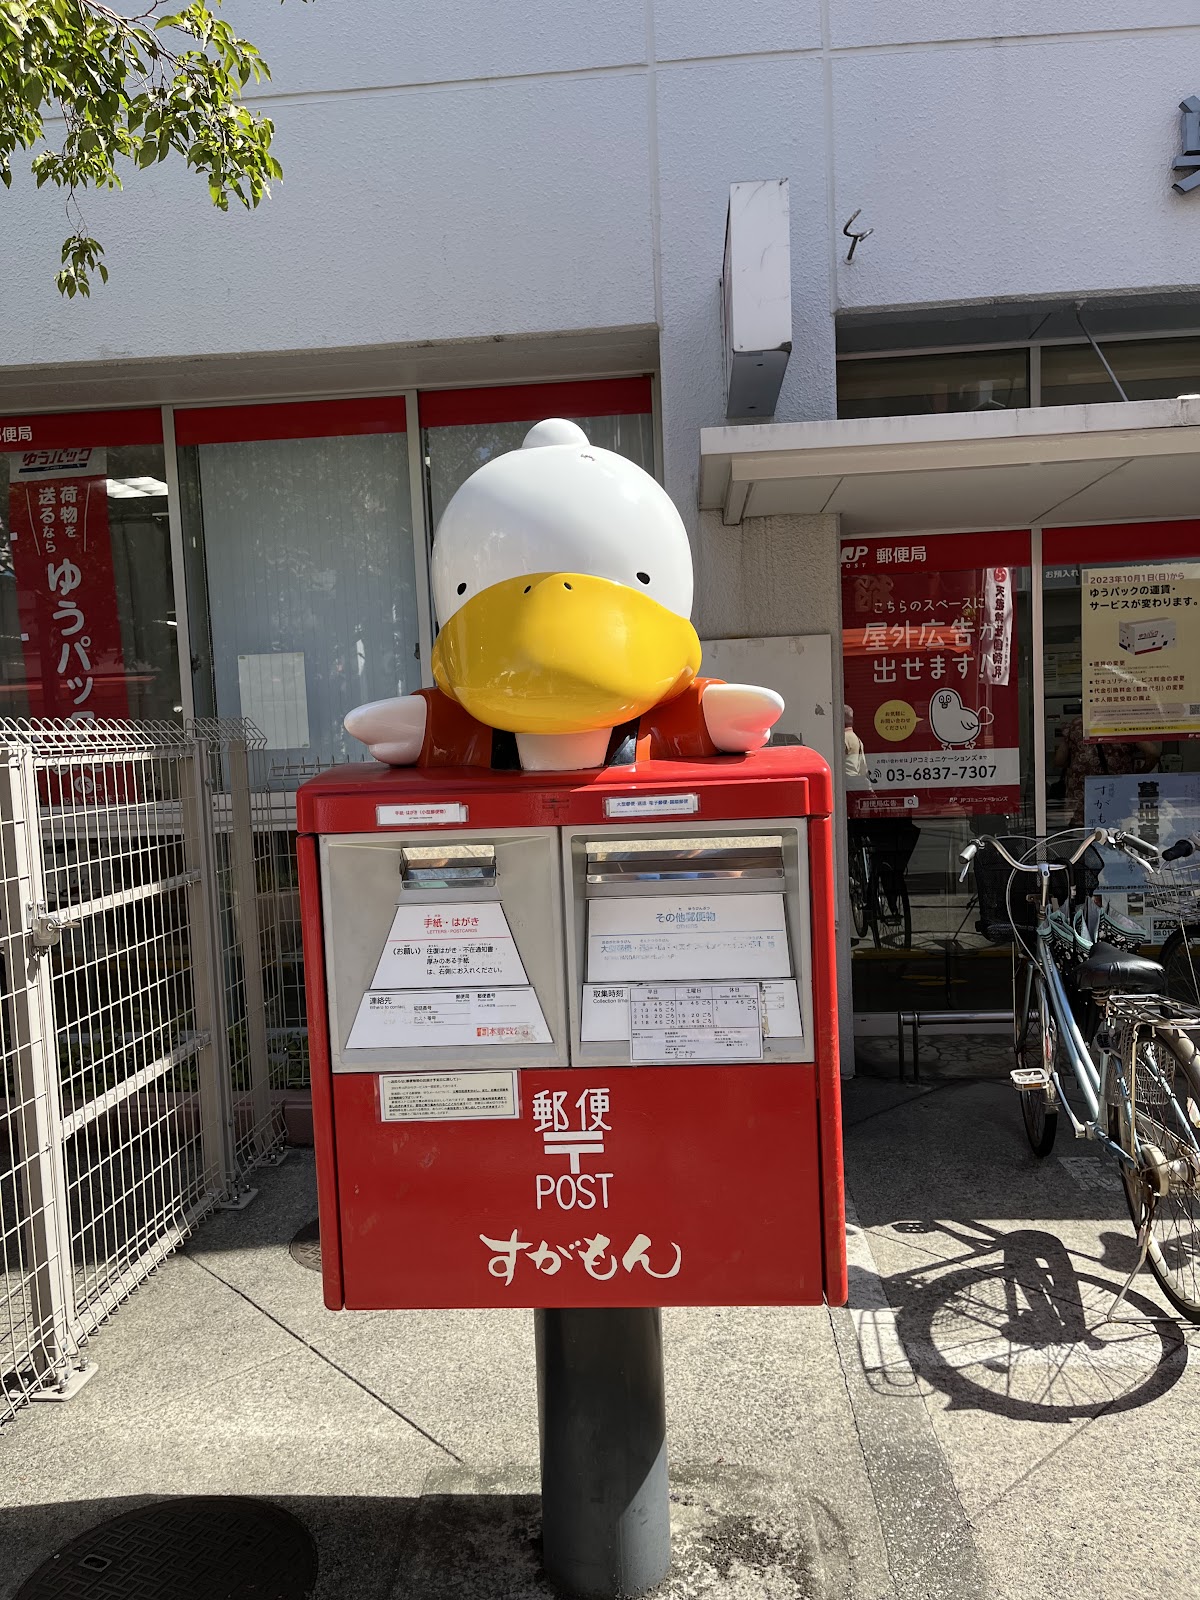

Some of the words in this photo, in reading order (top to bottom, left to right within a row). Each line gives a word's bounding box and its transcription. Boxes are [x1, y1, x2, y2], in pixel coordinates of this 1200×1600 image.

[0, 425, 33, 443] 便局
[22, 447, 93, 466] ゆうパック
[38, 486, 57, 554] 送るなら
[59, 485, 79, 539] 荷物を
[876, 545, 927, 564] 郵便局
[1090, 572, 1185, 585] 2023年10月1日(日)から
[873, 597, 985, 614] こちらのスペースに
[1089, 596, 1198, 611] サービスが変わります。
[861, 616, 998, 651] 屋外広告が
[886, 765, 998, 782] 03-6837-7307
[423, 917, 480, 928] 手紙・はがき
[655, 911, 716, 923] その他郵便物
[392, 947, 422, 956] （お願い）
[426, 957, 470, 965] 厚みのある手紙
[426, 966, 503, 975] は、右側にお入れください。
[369, 996, 393, 1005] 連絡先
[592, 989, 624, 998] 取集時刻
[532, 1087, 612, 1132] 郵便
[535, 1172, 614, 1210] POST
[479, 1228, 682, 1287] すがもん
